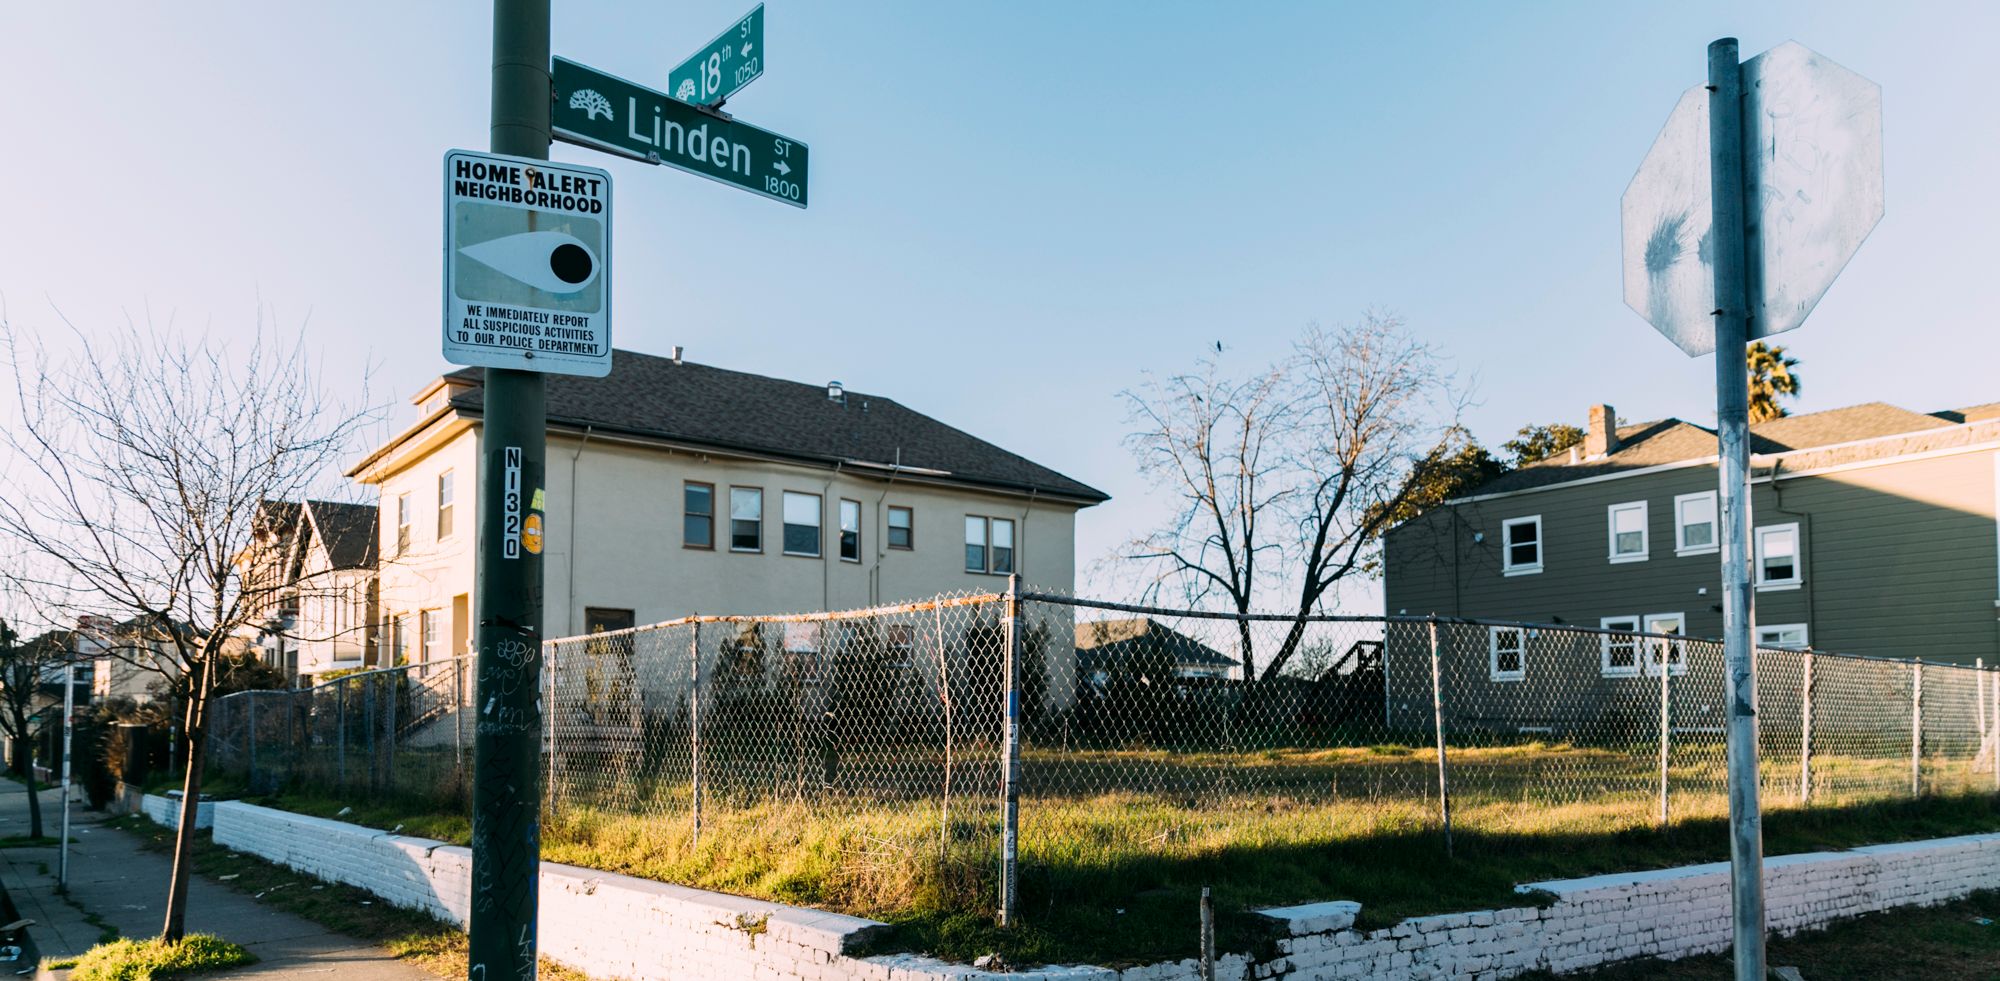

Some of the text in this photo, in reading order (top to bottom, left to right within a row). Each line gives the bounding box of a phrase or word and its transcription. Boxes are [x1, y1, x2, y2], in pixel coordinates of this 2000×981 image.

[740, 16, 752, 39] ST
[699, 44, 732, 100] 18th
[734, 56, 758, 86] 1050
[628, 96, 751, 177] Linden
[773, 138, 792, 158] ST
[456, 160, 601, 197] HOME ALERT
[764, 175, 800, 201] 1800
[455, 180, 603, 215] NEIGHBORHOOD
[467, 304, 589, 328] WE IMMEDIATELY REPORT
[456, 330, 599, 355] TO OUR POLICE DEPARTMENT
[463, 317, 594, 342] ALL SUSPICIOUS ACTIVITIES
